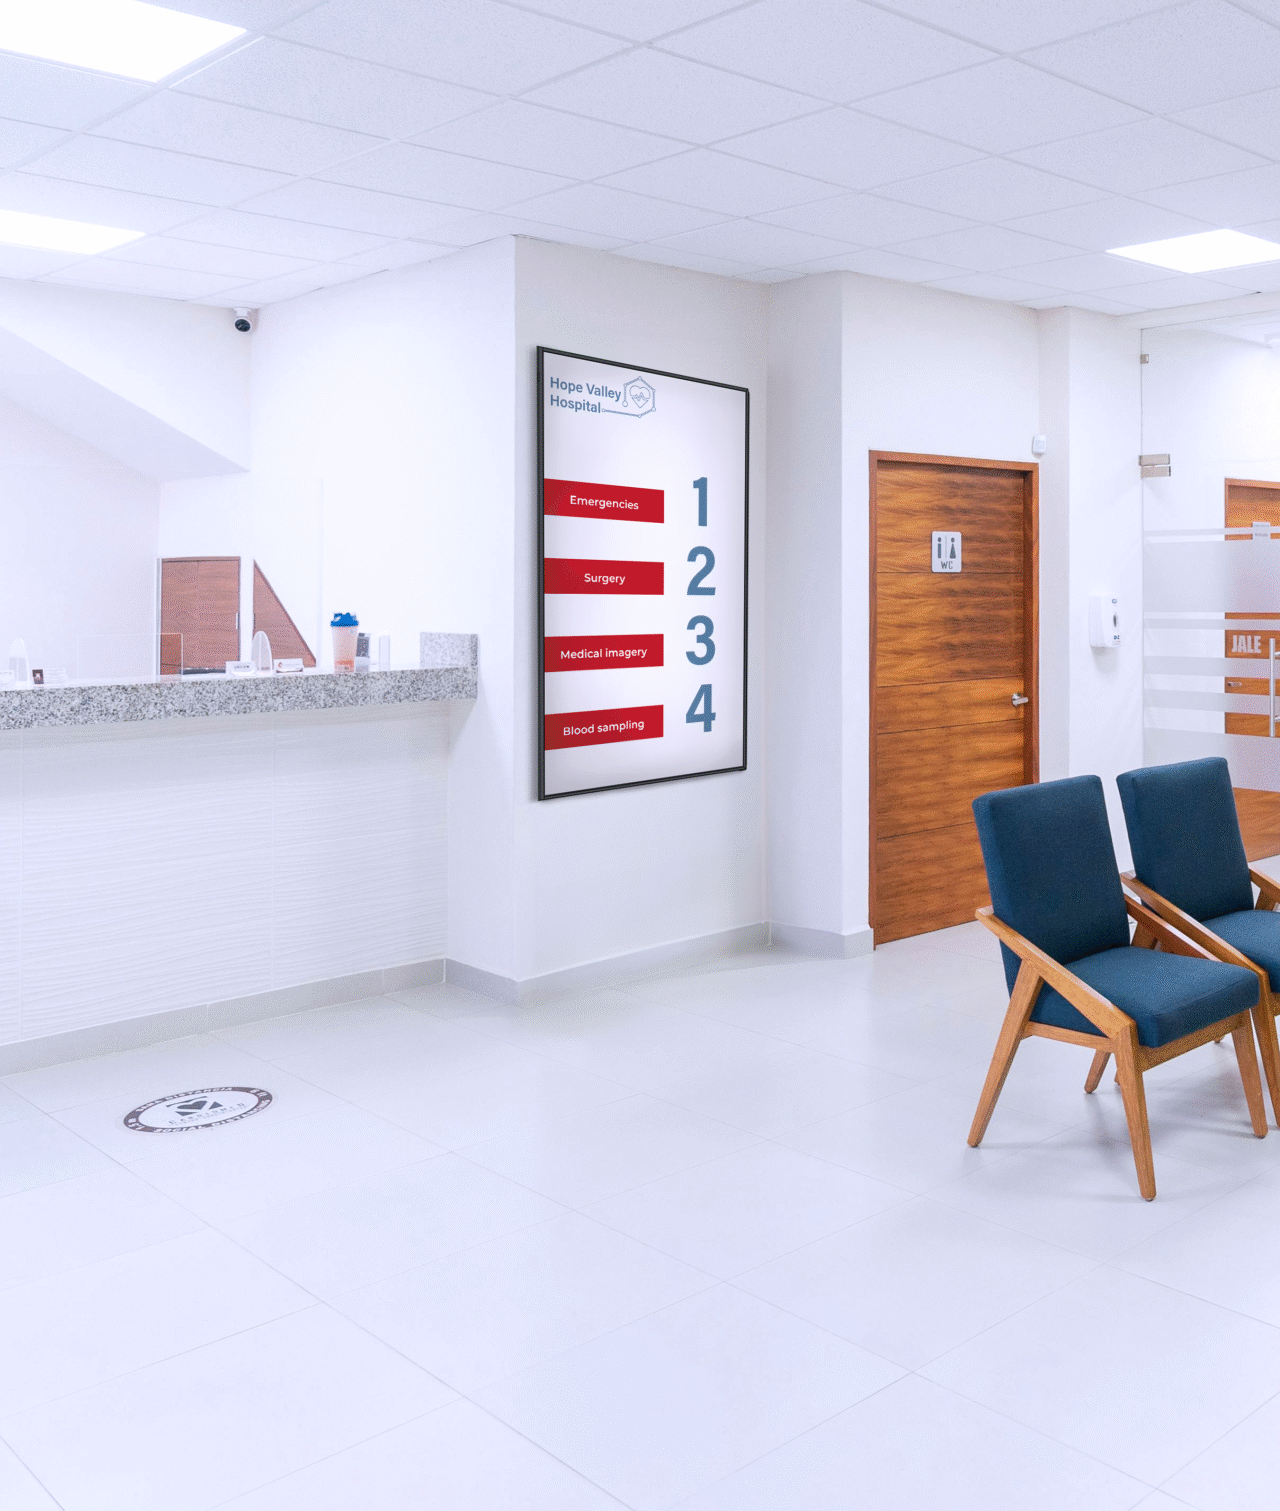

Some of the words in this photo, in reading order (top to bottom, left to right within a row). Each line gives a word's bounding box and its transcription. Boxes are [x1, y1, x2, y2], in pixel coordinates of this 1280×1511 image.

[550, 376, 584, 394] Hope
[586, 382, 622, 403] Valley
[550, 394, 601, 414] Hospital
[570, 494, 640, 511] Emergencies
[692, 476, 708, 527] 1
[686, 545, 717, 596] 2
[940, 560, 953, 570] WC
[584, 573, 626, 586] Surgery
[685, 614, 716, 666] 3
[1231, 634, 1262, 654] JALE
[560, 648, 603, 660] Medical
[604, 646, 648, 661] imagery
[685, 683, 717, 733] 4
[562, 724, 595, 737] Blood
[597, 718, 646, 735] sampling
